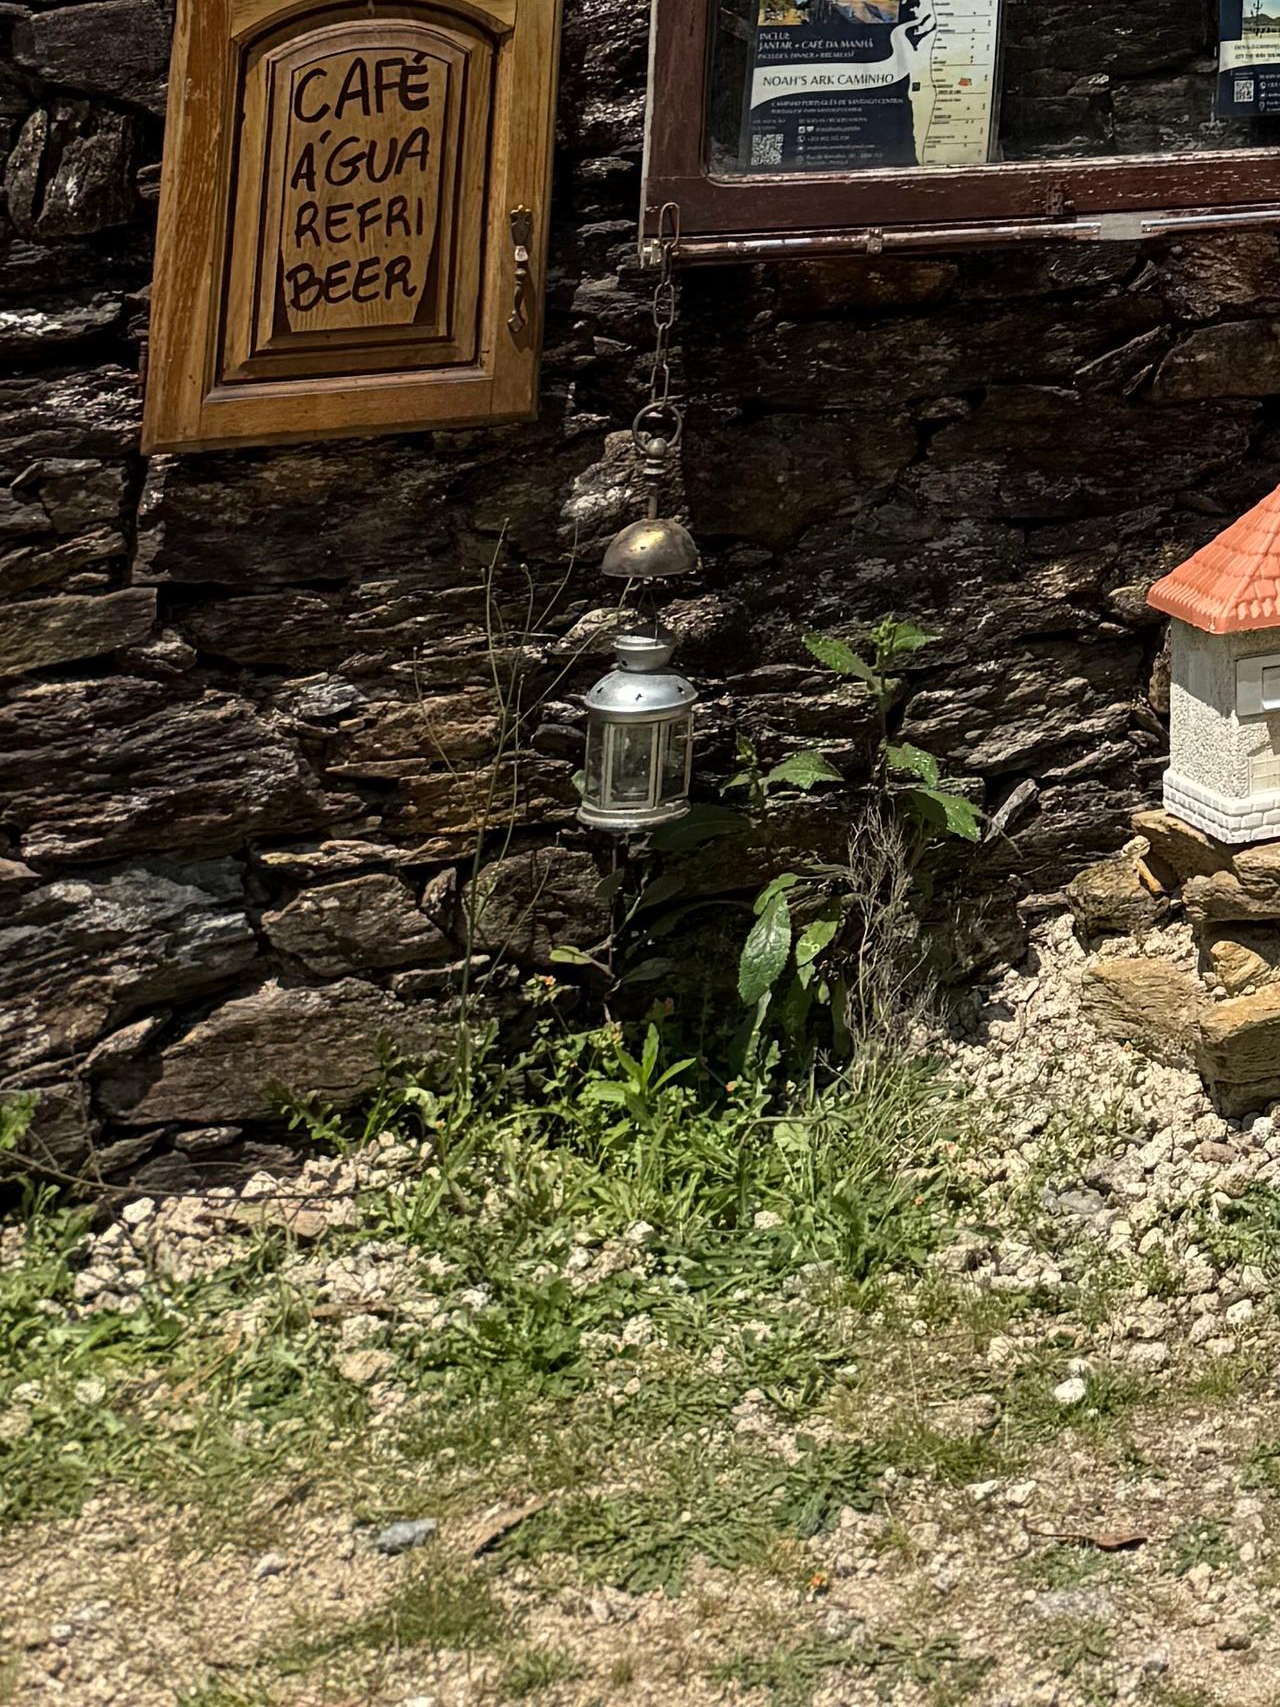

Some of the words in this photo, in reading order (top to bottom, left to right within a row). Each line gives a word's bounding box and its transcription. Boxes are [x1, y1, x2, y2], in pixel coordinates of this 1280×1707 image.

[293, 51, 430, 124] CAFÉ
[763, 75, 808, 86] NOAH'S
[810, 75, 834, 85] ARK
[837, 73, 894, 85] CAMINHO
[291, 127, 430, 192] ÁGUA
[293, 195, 424, 248] REFRI
[286, 256, 417, 312] BEER
